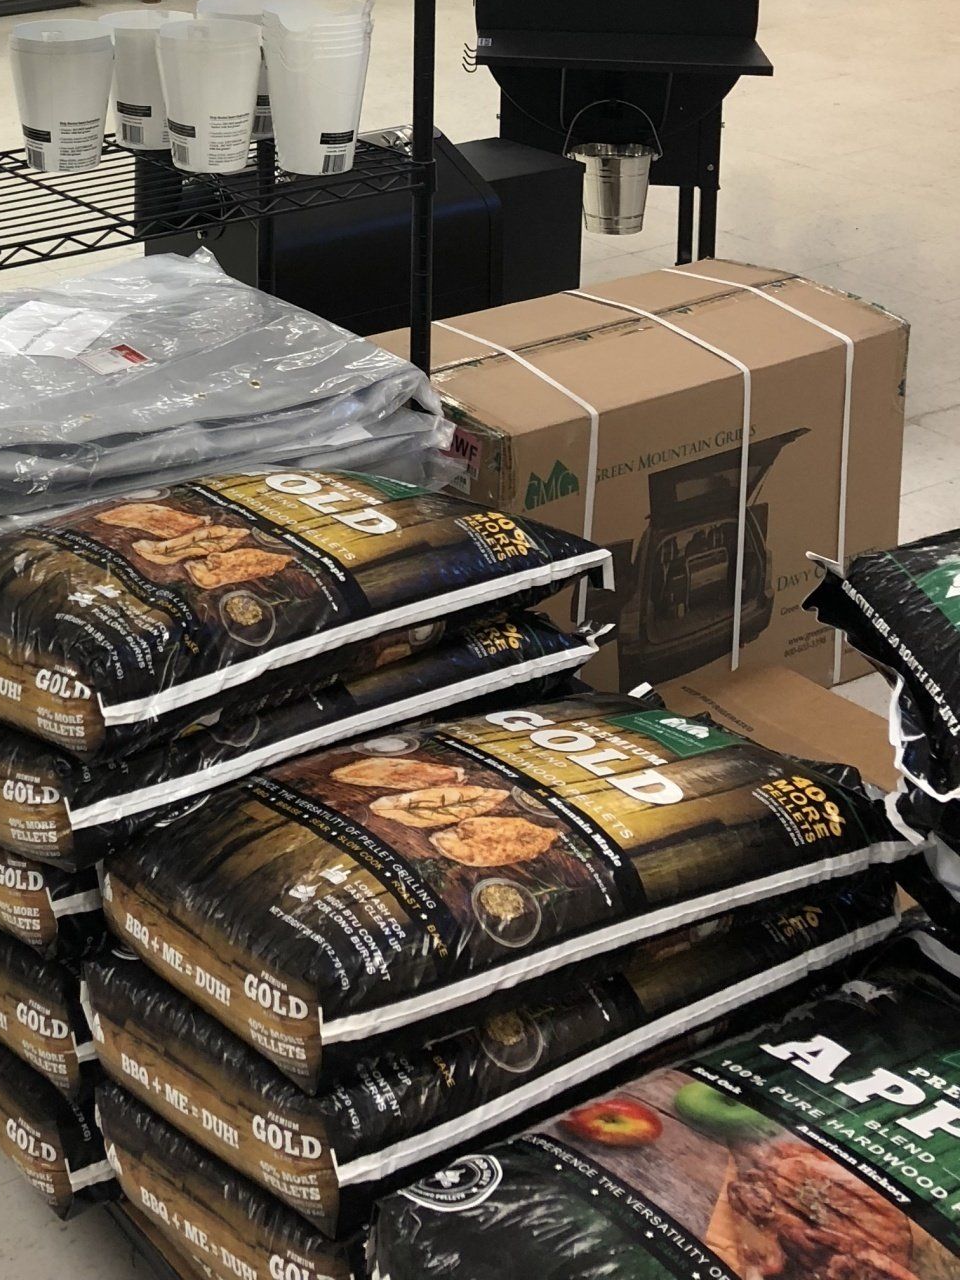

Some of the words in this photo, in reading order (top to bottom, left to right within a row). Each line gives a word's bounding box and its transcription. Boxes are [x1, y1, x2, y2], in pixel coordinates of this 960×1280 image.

[640, 440, 711, 469] MOUNTAIN
[243, 471, 397, 534] OLD
[283, 534, 320, 559] Mountain
[320, 557, 345, 582] Maple
[463, 516, 507, 561] PELLETS
[472, 514, 519, 558] MORE
[487, 512, 531, 557] 40%
[35, 669, 91, 699] GOLD
[486, 711, 684, 804] GOLD
[572, 721, 668, 766] PREMIUM
[3, 780, 60, 804] GOLD
[490, 744, 566, 787] HARDWOOD
[568, 789, 635, 840] PELLETS
[761, 784, 815, 843] PELLETS
[773, 779, 829, 839] MORE
[791, 775, 846, 837] 40%
[278, 788, 296, 802] THE
[298, 796, 347, 828] VERSATILITY
[346, 826, 359, 839] OF
[359, 835, 394, 862] PELLET
[392, 863, 436, 909] GRILLING
[548, 798, 593, 835] Mountain
[592, 832, 622, 867] Maple
[313, 900, 330, 914] FOR
[329, 913, 353, 935] LONG
[350, 936, 375, 975] BURNS
[323, 895, 343, 909] HIGH
[343, 909, 359, 928] BTU
[358, 928, 391, 981] CONTENT
[344, 885, 367, 907] EASY
[365, 905, 390, 936] CLEAN
[388, 938, 402, 952] UP
[373, 898, 390, 916] ASH
[388, 918, 406, 939] FOR
[125, 913, 149, 949] BBQ
[162, 941, 183, 972] ME
[195, 966, 231, 1006] DUH!
[16, 1002, 68, 1040] GOLD
[244, 974, 308, 1019] GOLD
[250, 1029, 306, 1060] PELLETS
[121, 1053, 149, 1090] BBQ
[165, 1083, 188, 1115] ME
[202, 1108, 239, 1149] DUH!
[721, 1060, 767, 1087] 100%
[770, 1086, 825, 1118] PURE
[826, 1120, 948, 1199] HARDWOOD
[6, 1118, 57, 1162] GOLD
[252, 1115, 322, 1159] GOLD
[796, 1125, 857, 1165] American
[857, 1163, 911, 1203] Hickory
[864, 1120, 936, 1164] BLEND
[522, 1134, 598, 1178] EXPERIENCE
[598, 1176, 625, 1198] THE
[626, 1196, 709, 1265] VERSATILITY
